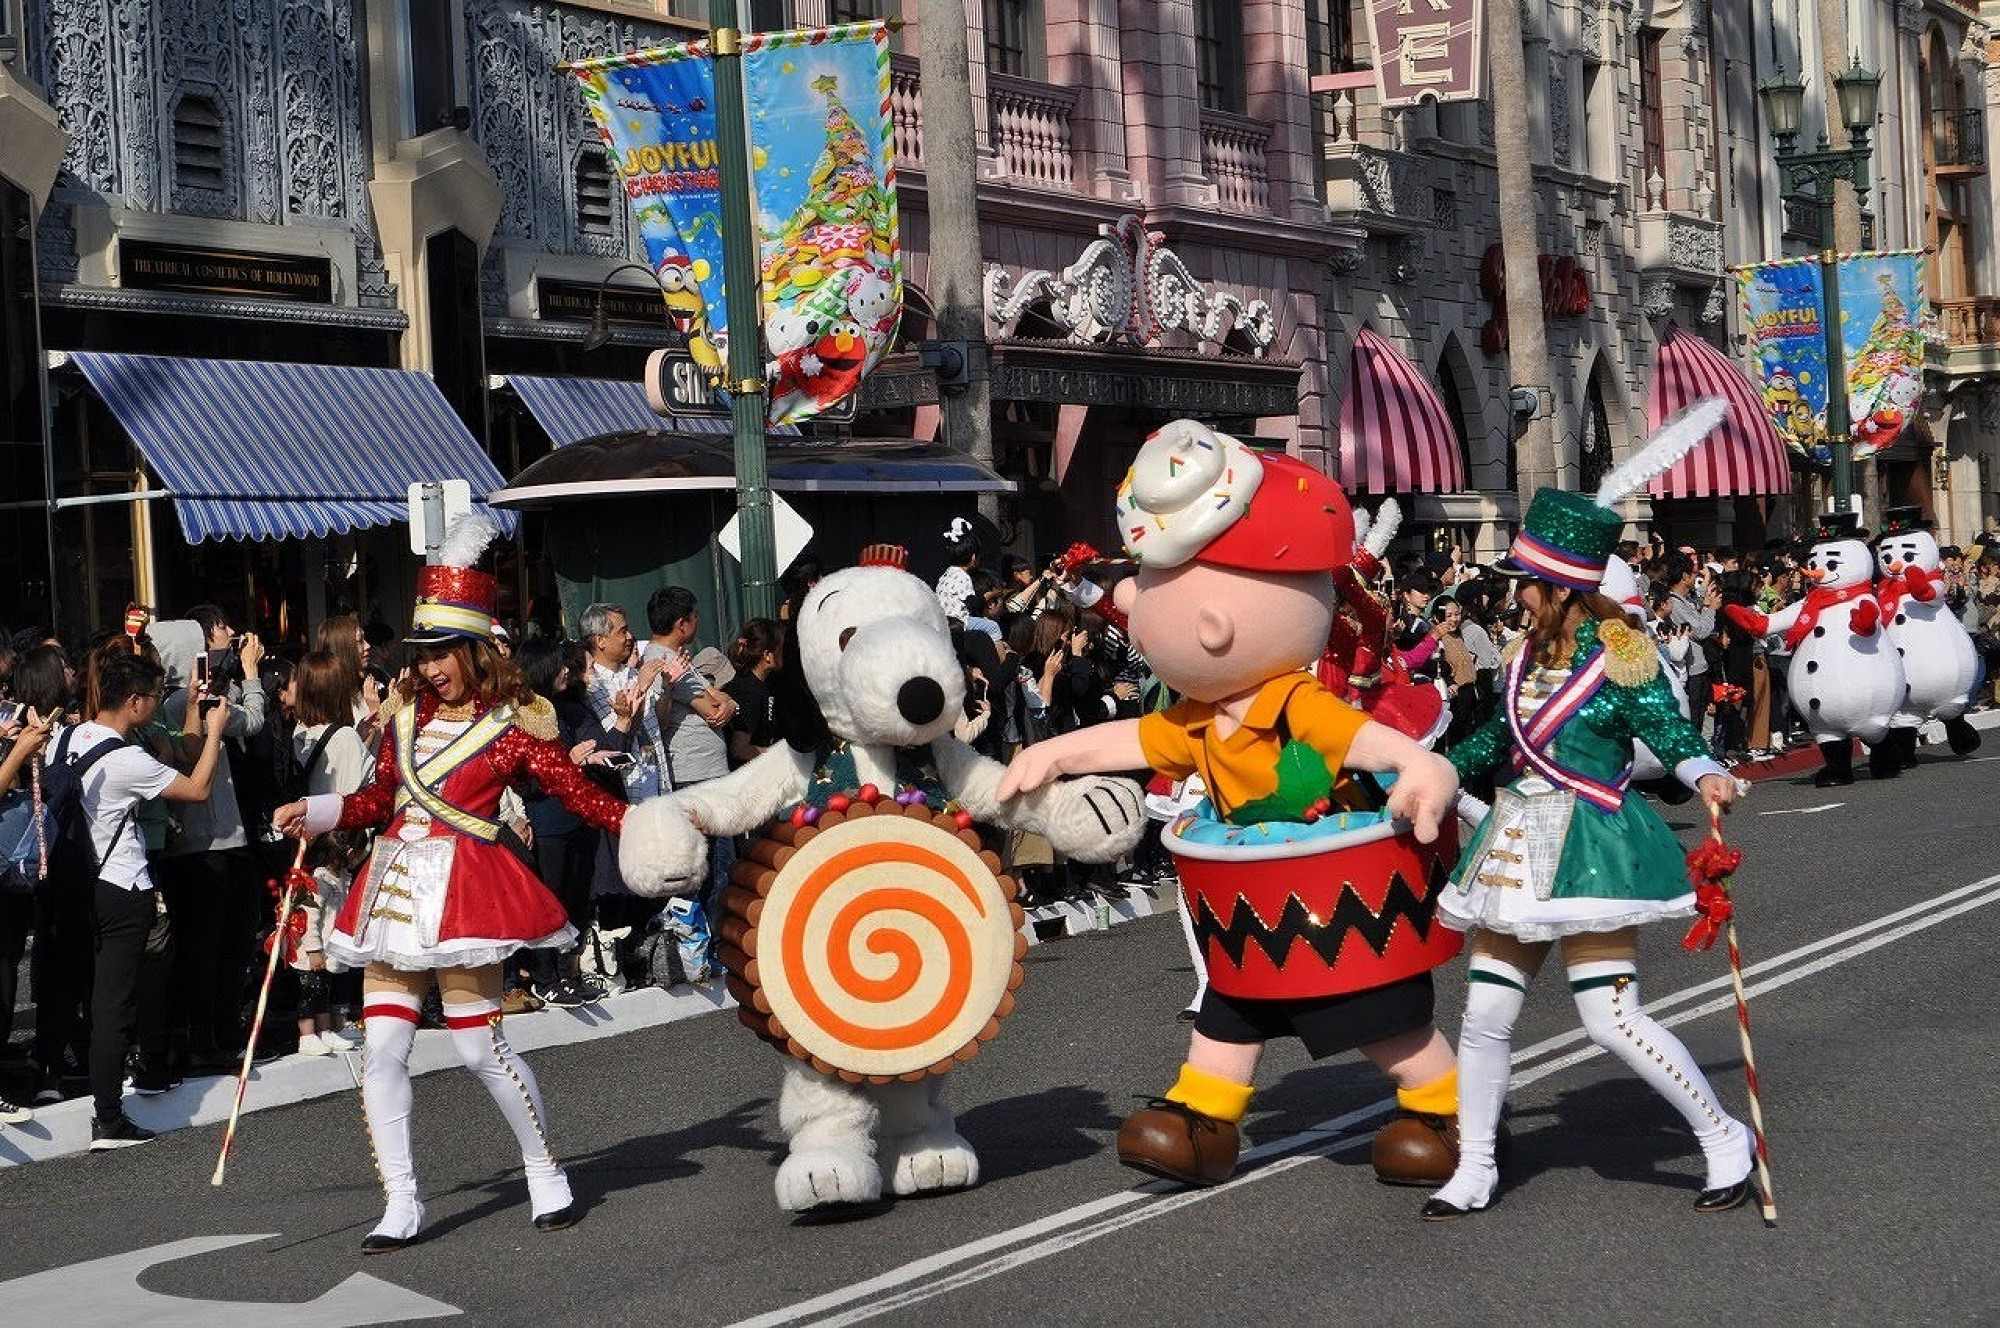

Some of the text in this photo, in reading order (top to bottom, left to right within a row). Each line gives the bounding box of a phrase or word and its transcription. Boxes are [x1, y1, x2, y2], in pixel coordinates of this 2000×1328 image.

[627, 169, 721, 199] CHRISTMA
[133, 258, 320, 287] THEATRICAL COSMETICS OF HOLLYWOOD
[1755, 308, 1819, 328] JOYFUL
